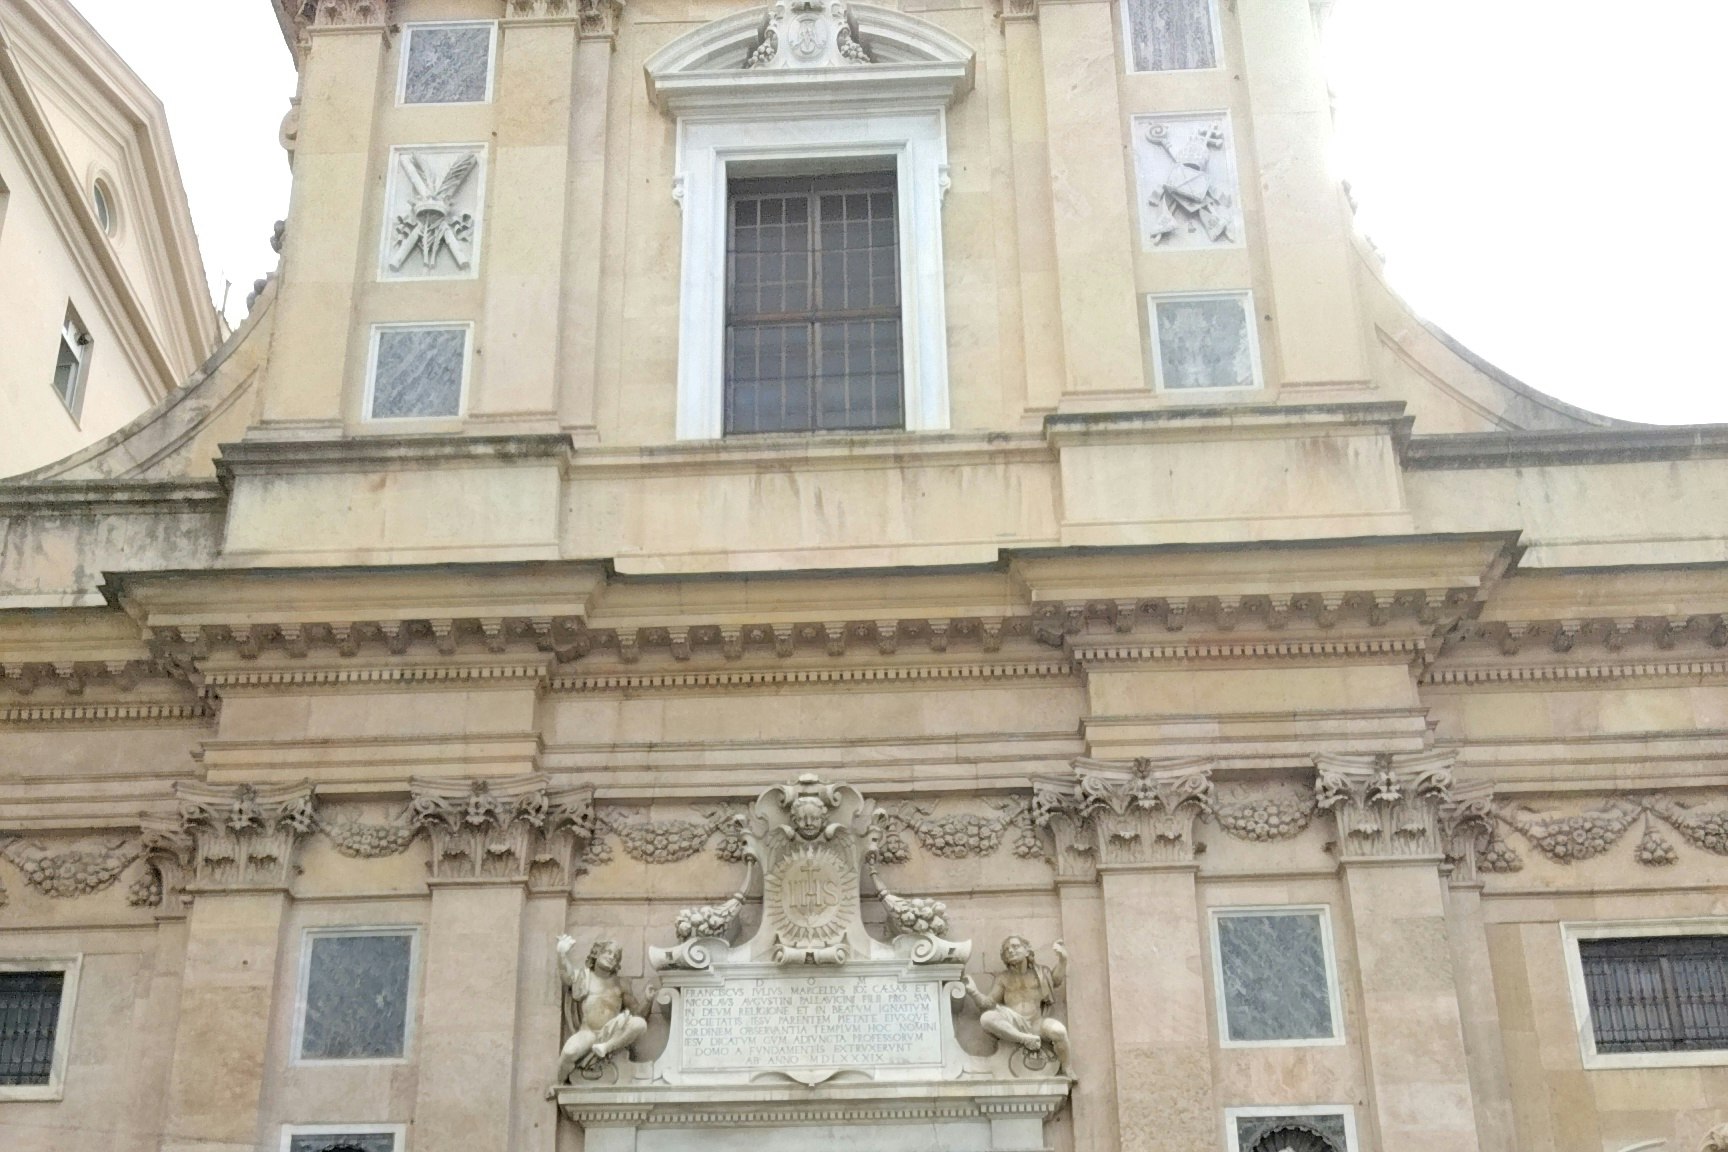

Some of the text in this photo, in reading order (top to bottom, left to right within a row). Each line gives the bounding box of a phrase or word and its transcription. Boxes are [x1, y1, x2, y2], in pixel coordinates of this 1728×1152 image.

[789, 880, 839, 907] IHS
[756, 979, 764, 987] D
[808, 976, 816, 985] O
[686, 988, 744, 997] FRANCISCVS
[752, 988, 783, 996] IVLIVS
[915, 984, 928, 992] ET
[686, 998, 734, 1007] NICOLAVS
[888, 994, 907, 1002] PRO
[914, 993, 932, 1002] SVA
[685, 1003, 929, 1017] IN DEVM RELIGIONE ET IN BEATVM IGNATIVM
[685, 1018, 743, 1027] SOCIETATIS
[751, 1016, 771, 1026] IESV
[779, 1015, 830, 1024] PARENTEM
[685, 1028, 732, 1037] ORDINEM
[814, 1024, 861, 1034] TEMPLVM
[868, 1024, 891, 1032] HOC
[685, 1032, 924, 1046] IESV DICATVM CVM ADIVNCTA PROFESSORVM
[695, 1043, 913, 1056] DOMO A FVNDAMENTIS EXTRVXERVNT
[745, 1056, 760, 1065] AB
[768, 1056, 799, 1064] ANNO
